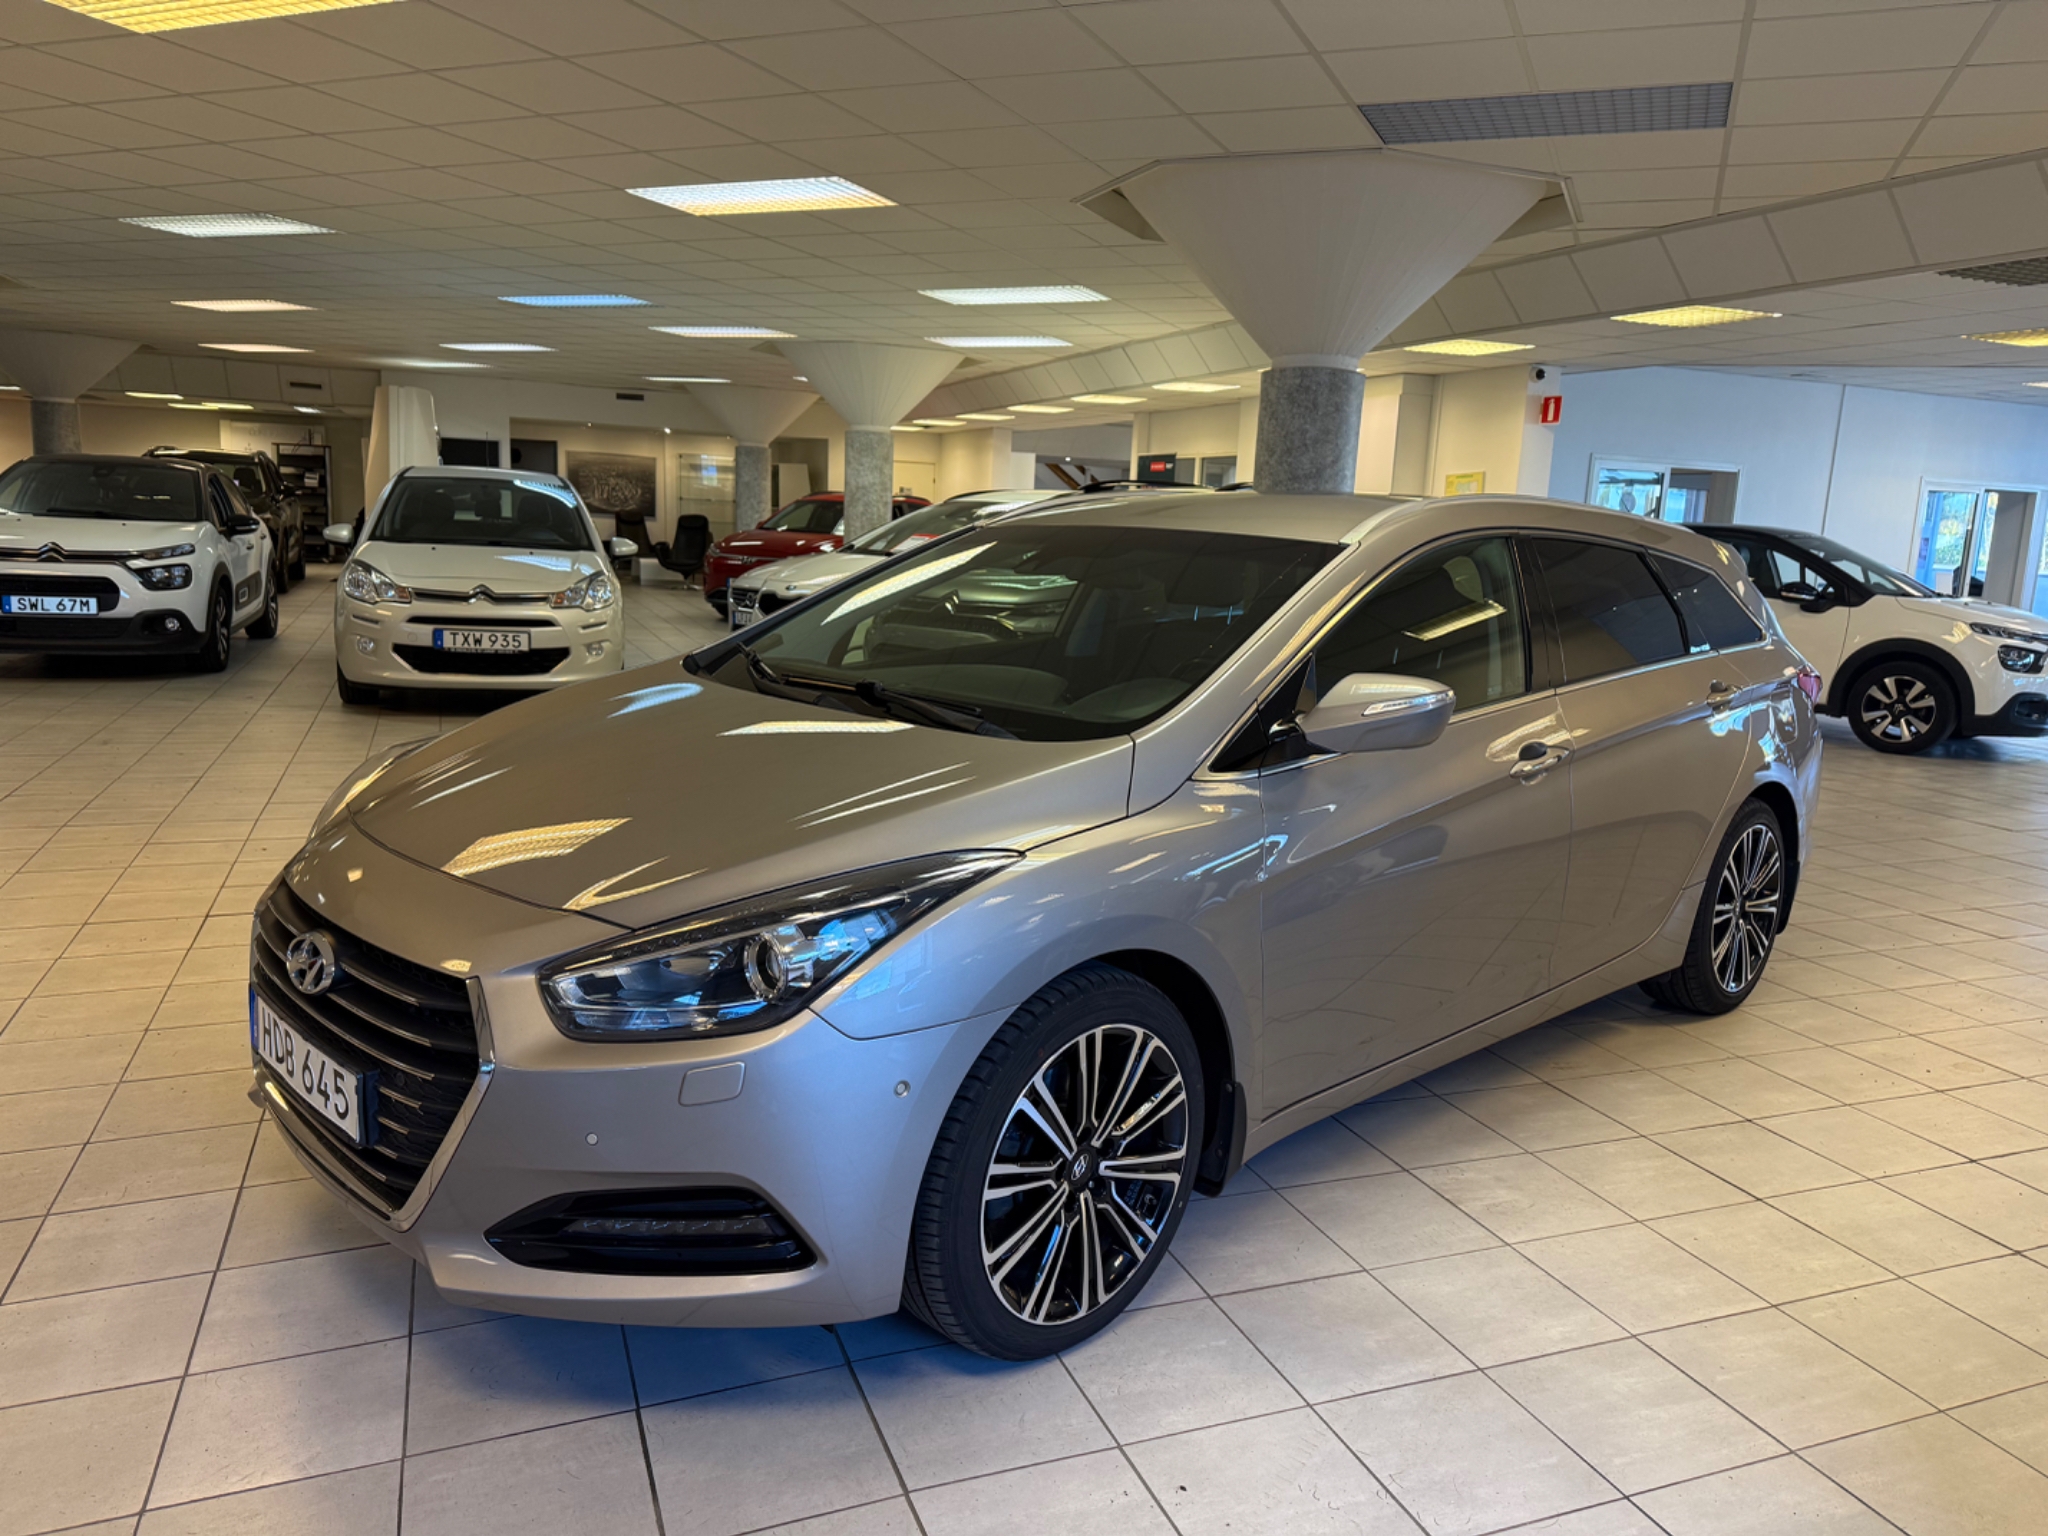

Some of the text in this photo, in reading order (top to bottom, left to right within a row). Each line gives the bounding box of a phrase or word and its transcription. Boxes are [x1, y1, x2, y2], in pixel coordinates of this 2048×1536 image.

[17, 597, 91, 612] SWL 67M
[449, 632, 522, 649] TXW 935
[262, 1006, 349, 1120] HDB 645
